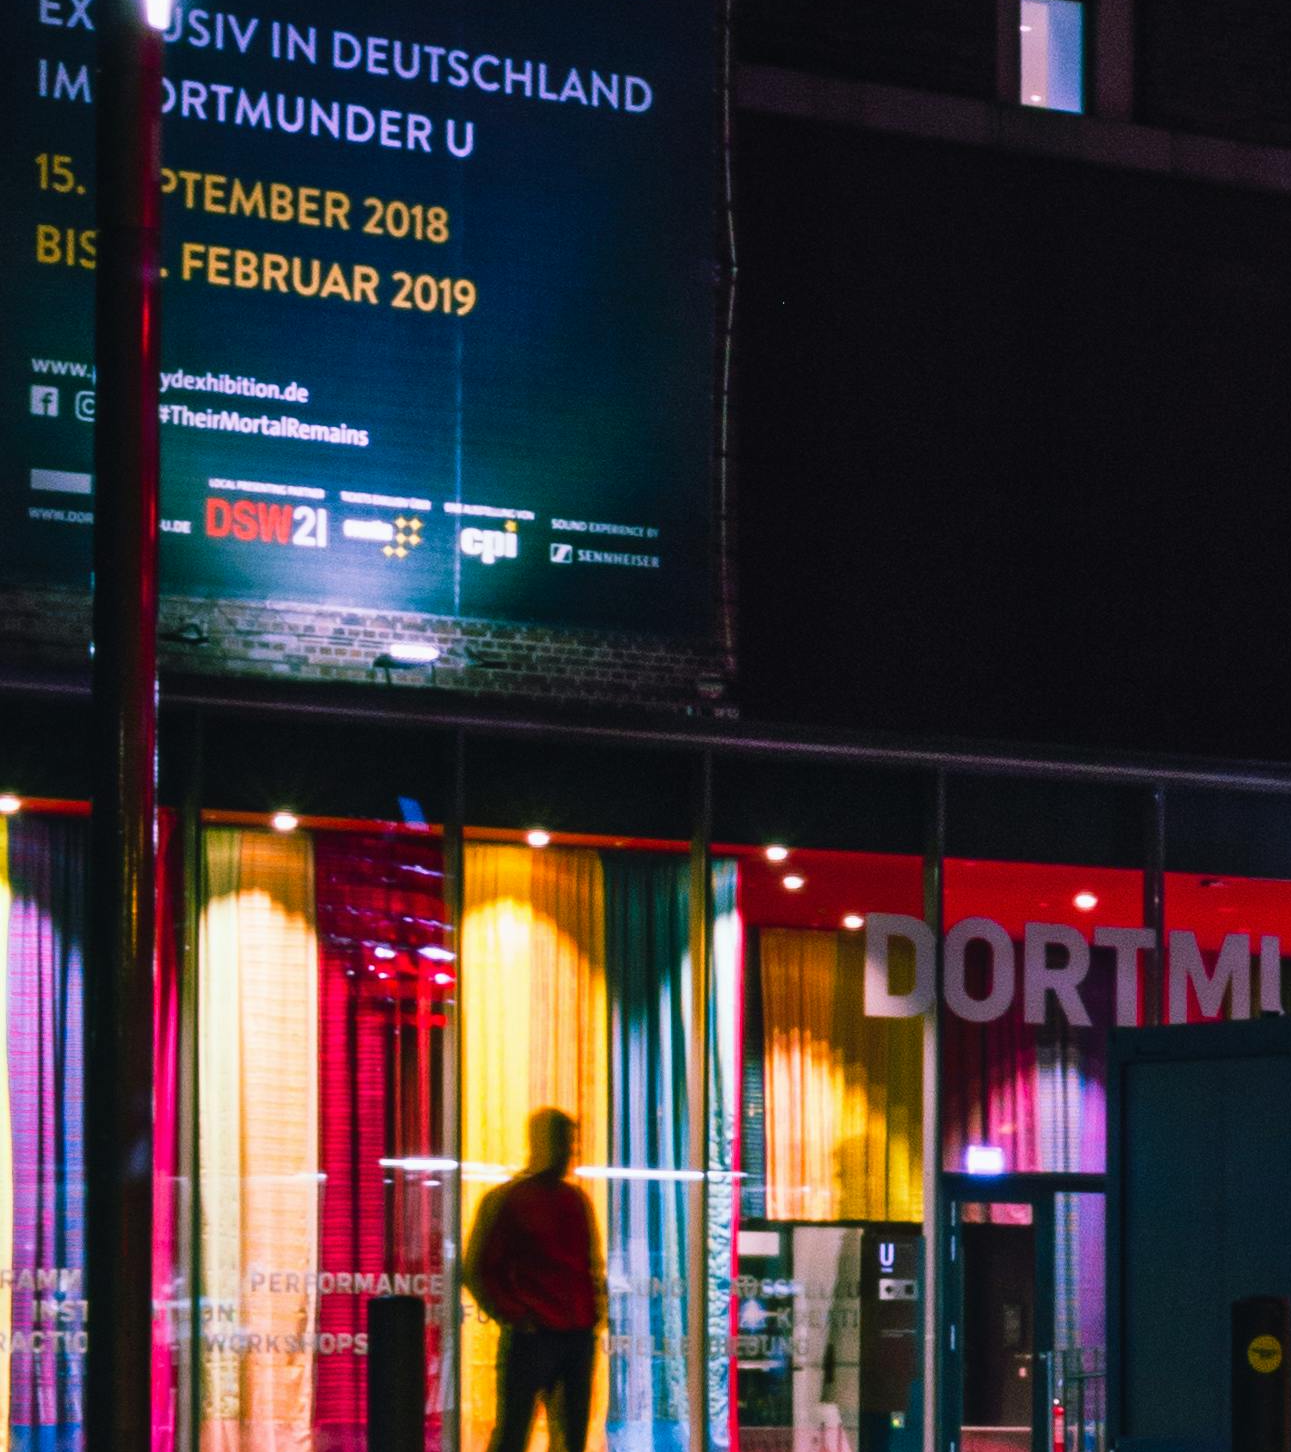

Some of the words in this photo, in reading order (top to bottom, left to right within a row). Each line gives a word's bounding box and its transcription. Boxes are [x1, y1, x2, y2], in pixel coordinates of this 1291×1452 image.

[37, 58, 93, 104] IM
[445, 119, 475, 158] U
[271, 20, 318, 64] IN
[332, 30, 654, 114] DEUTSCHLAND
[35, 152, 86, 195] 15.
[362, 196, 450, 244] 2018
[181, 242, 380, 306] FEBRUAR
[390, 269, 478, 317] 2019
[577, 549, 660, 568] SENNHEISER
[250, 1271, 444, 1296] PERFORMANCE
